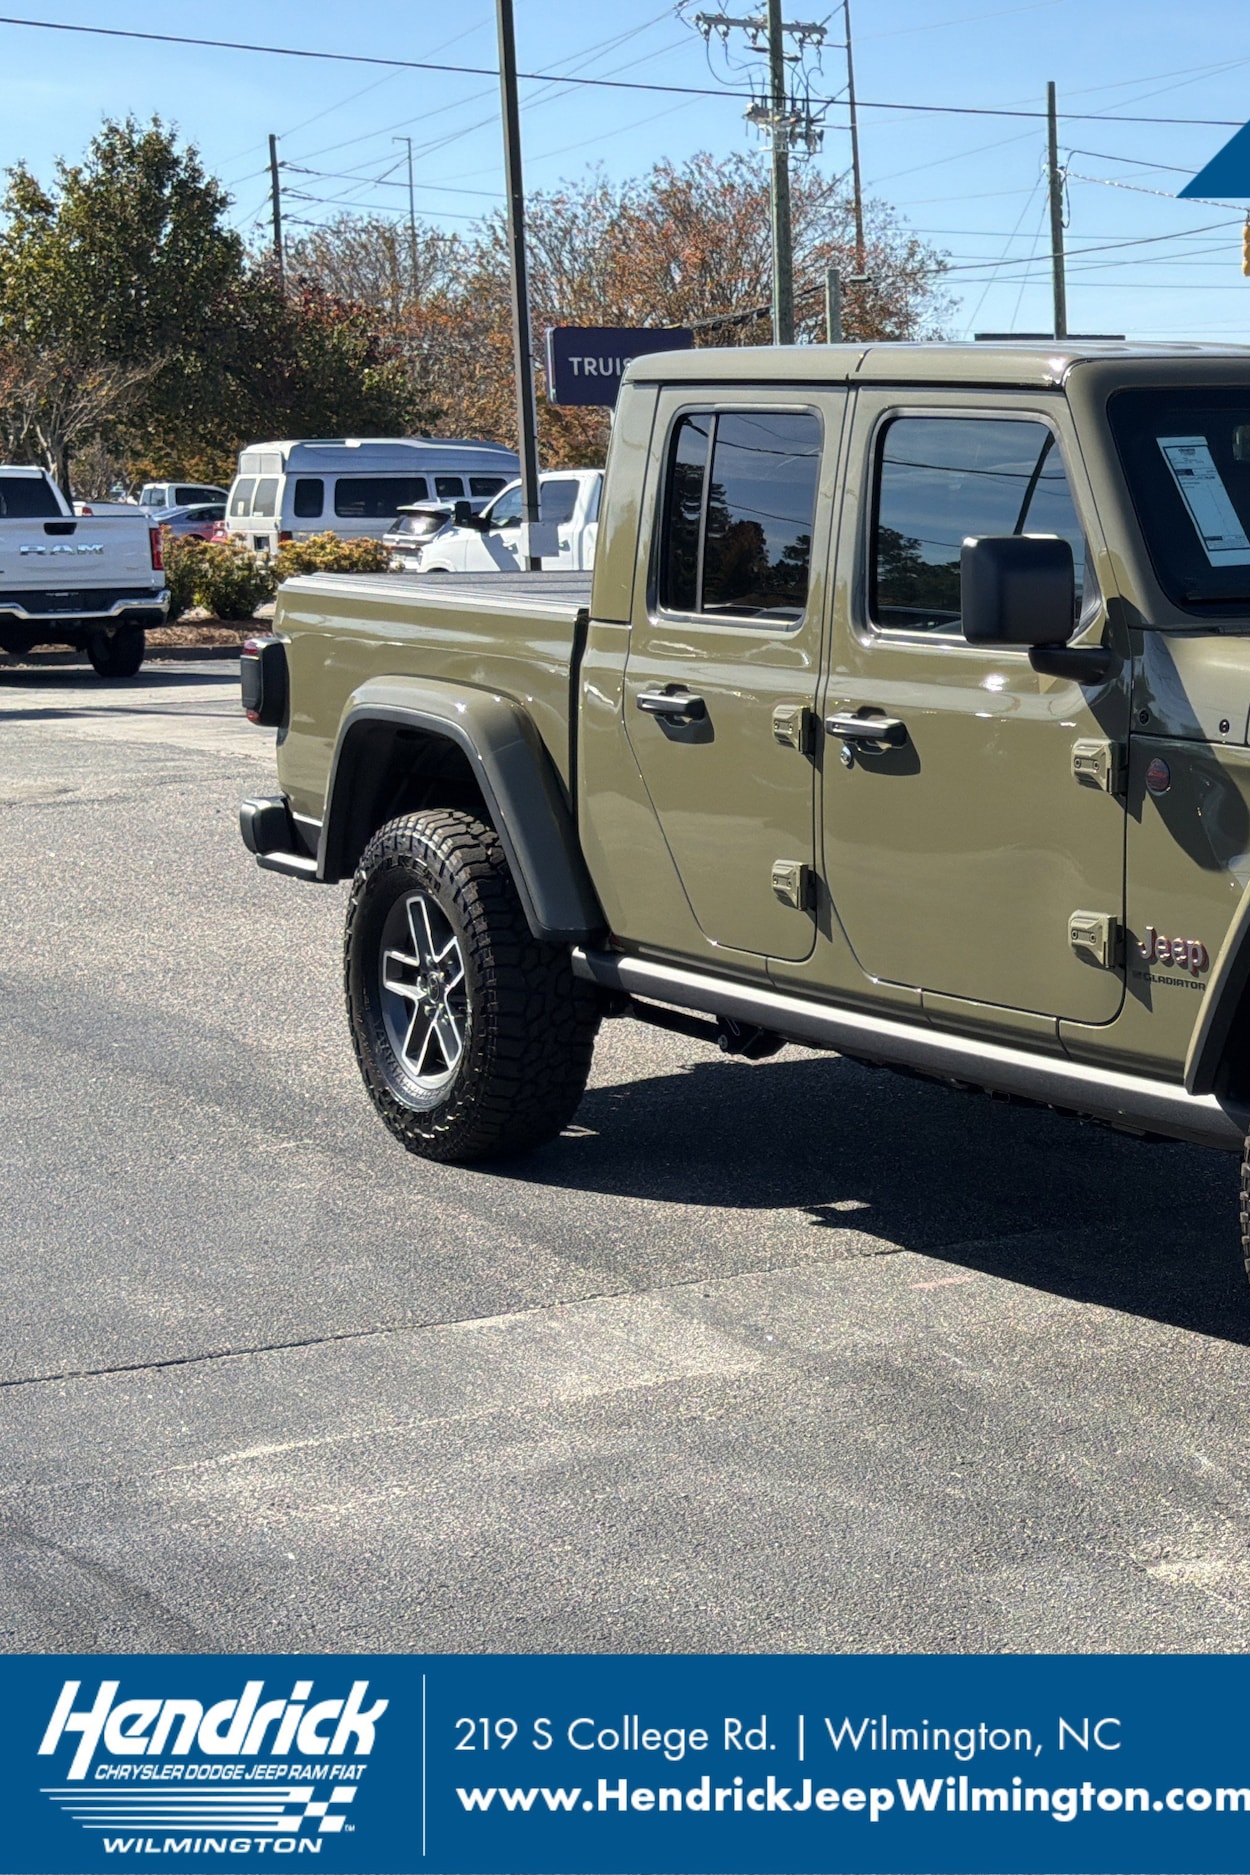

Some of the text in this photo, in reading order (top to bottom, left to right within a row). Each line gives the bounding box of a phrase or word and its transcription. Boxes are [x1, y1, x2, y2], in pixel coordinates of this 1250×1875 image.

[20, 544, 104, 556] RAM
[1137, 926, 1206, 974] Jeep
[1143, 972, 1206, 991] GLADIATOR
